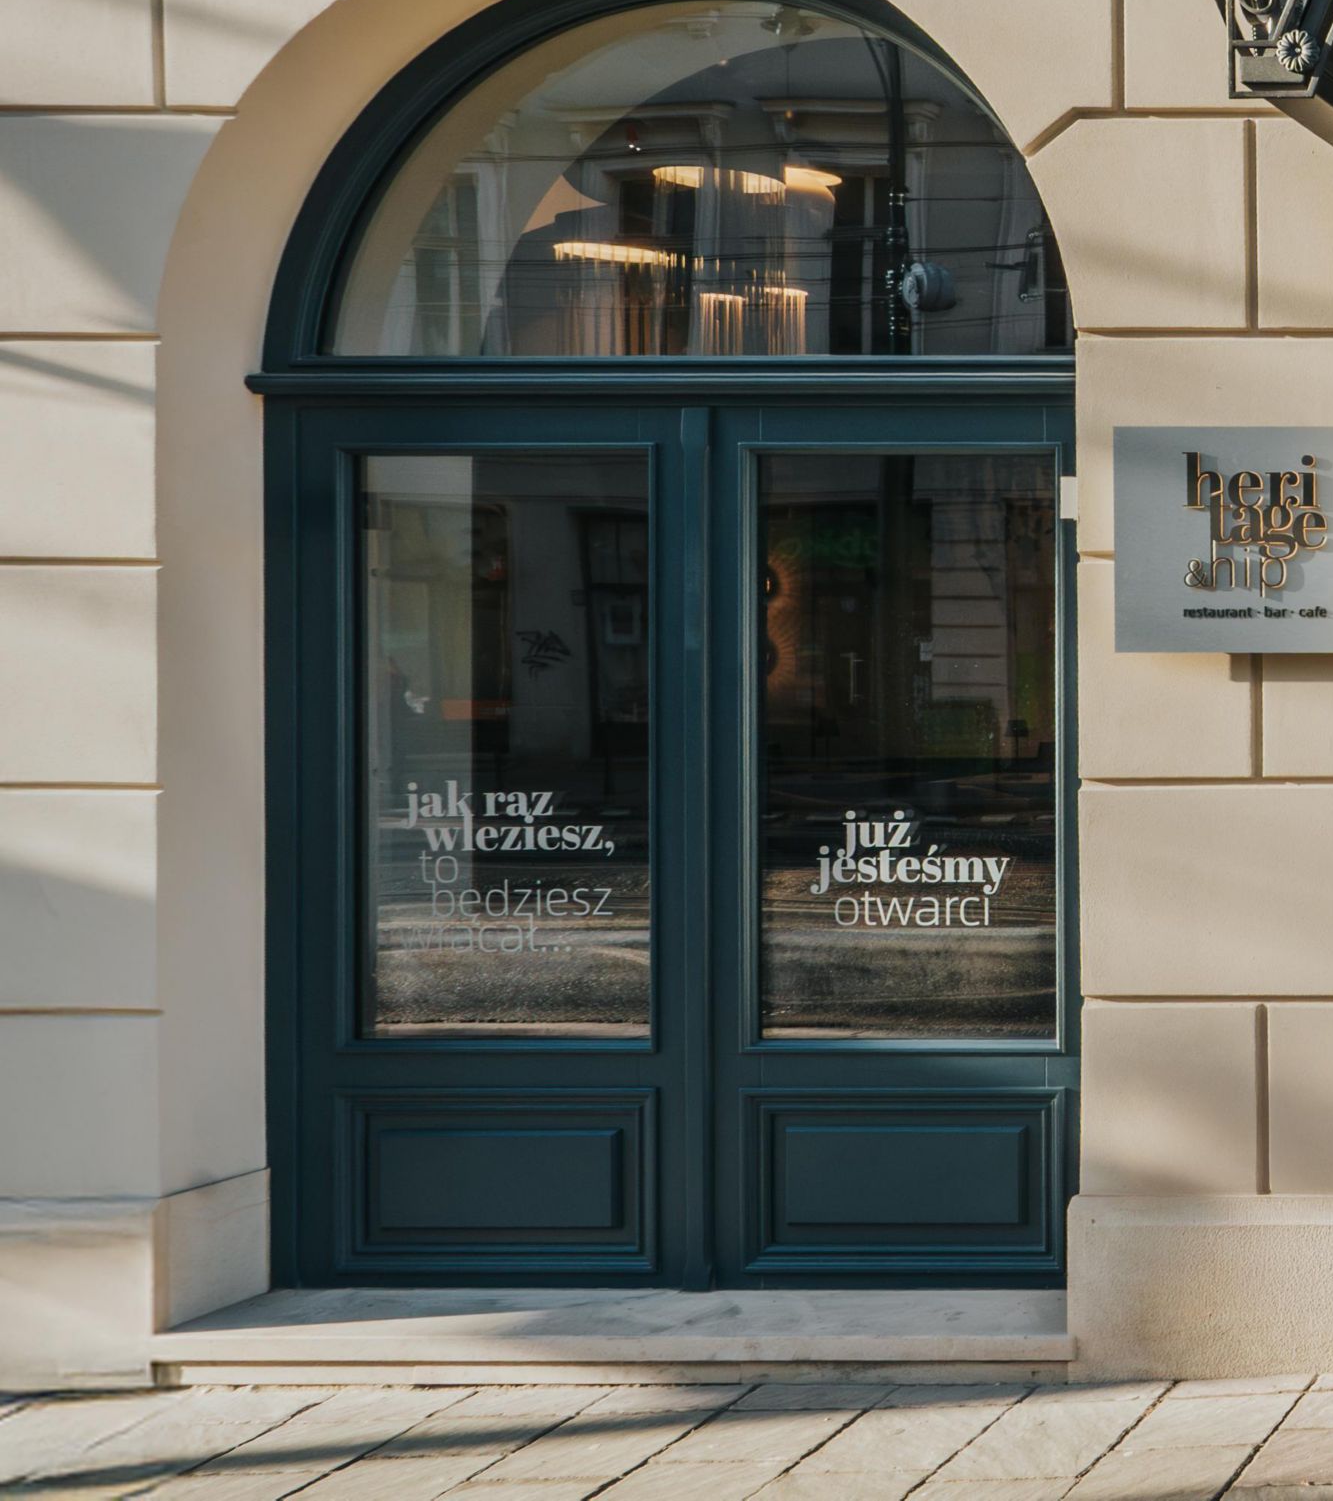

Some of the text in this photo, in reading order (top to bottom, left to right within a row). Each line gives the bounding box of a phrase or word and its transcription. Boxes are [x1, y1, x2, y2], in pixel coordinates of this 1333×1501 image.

[1182, 451, 1321, 509] heri
[1183, 606, 1328, 619] restaurant bar cafe
[401, 780, 475, 830] jak
[842, 810, 912, 858] już
[418, 850, 459, 884] to
[810, 844, 1010, 895] jesteśmy
[431, 878, 614, 925] będziesz
[834, 890, 991, 927] otwarci
